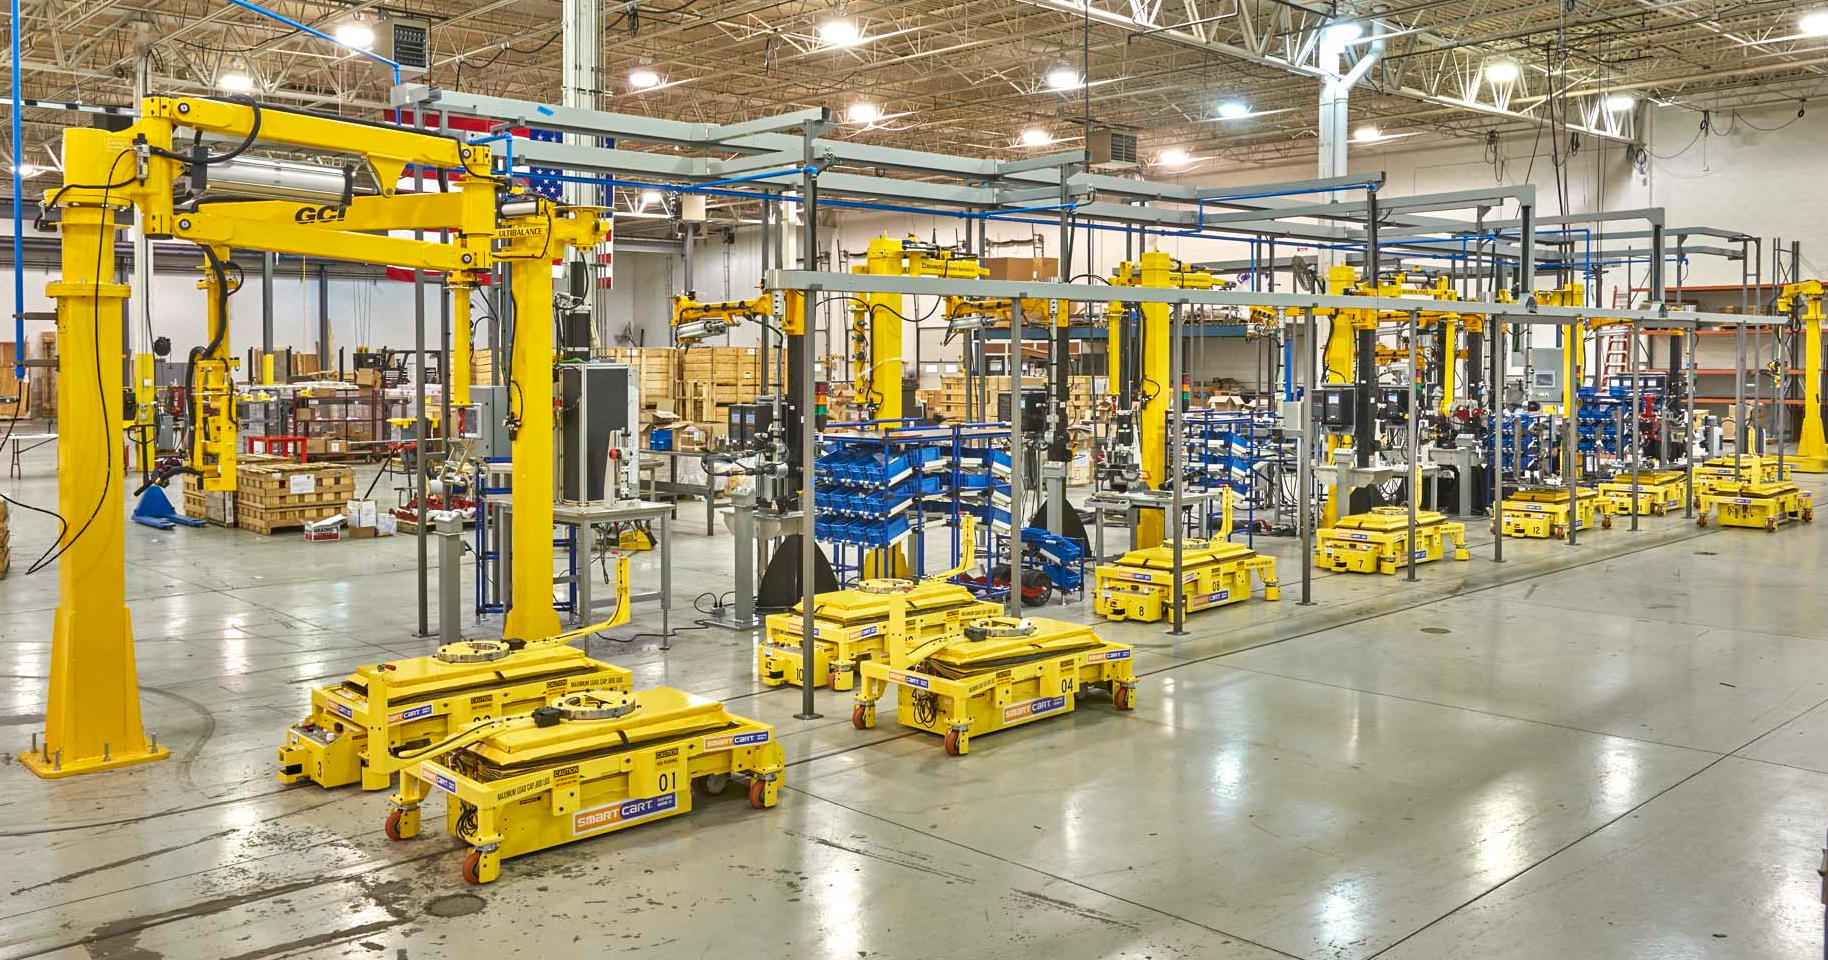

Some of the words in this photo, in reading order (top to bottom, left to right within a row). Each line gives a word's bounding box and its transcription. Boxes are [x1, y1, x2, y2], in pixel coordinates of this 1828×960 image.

[295, 206, 346, 224] GCI
[499, 227, 543, 237] ULTIBALANCE
[1533, 526, 1541, 535] 12
[1358, 560, 1364, 568] 7
[1139, 605, 1144, 617] 8
[1062, 678, 1073, 693] 04
[317, 761, 322, 777] 3
[554, 765, 579, 777] CAUTION
[658, 771, 676, 792] 01
